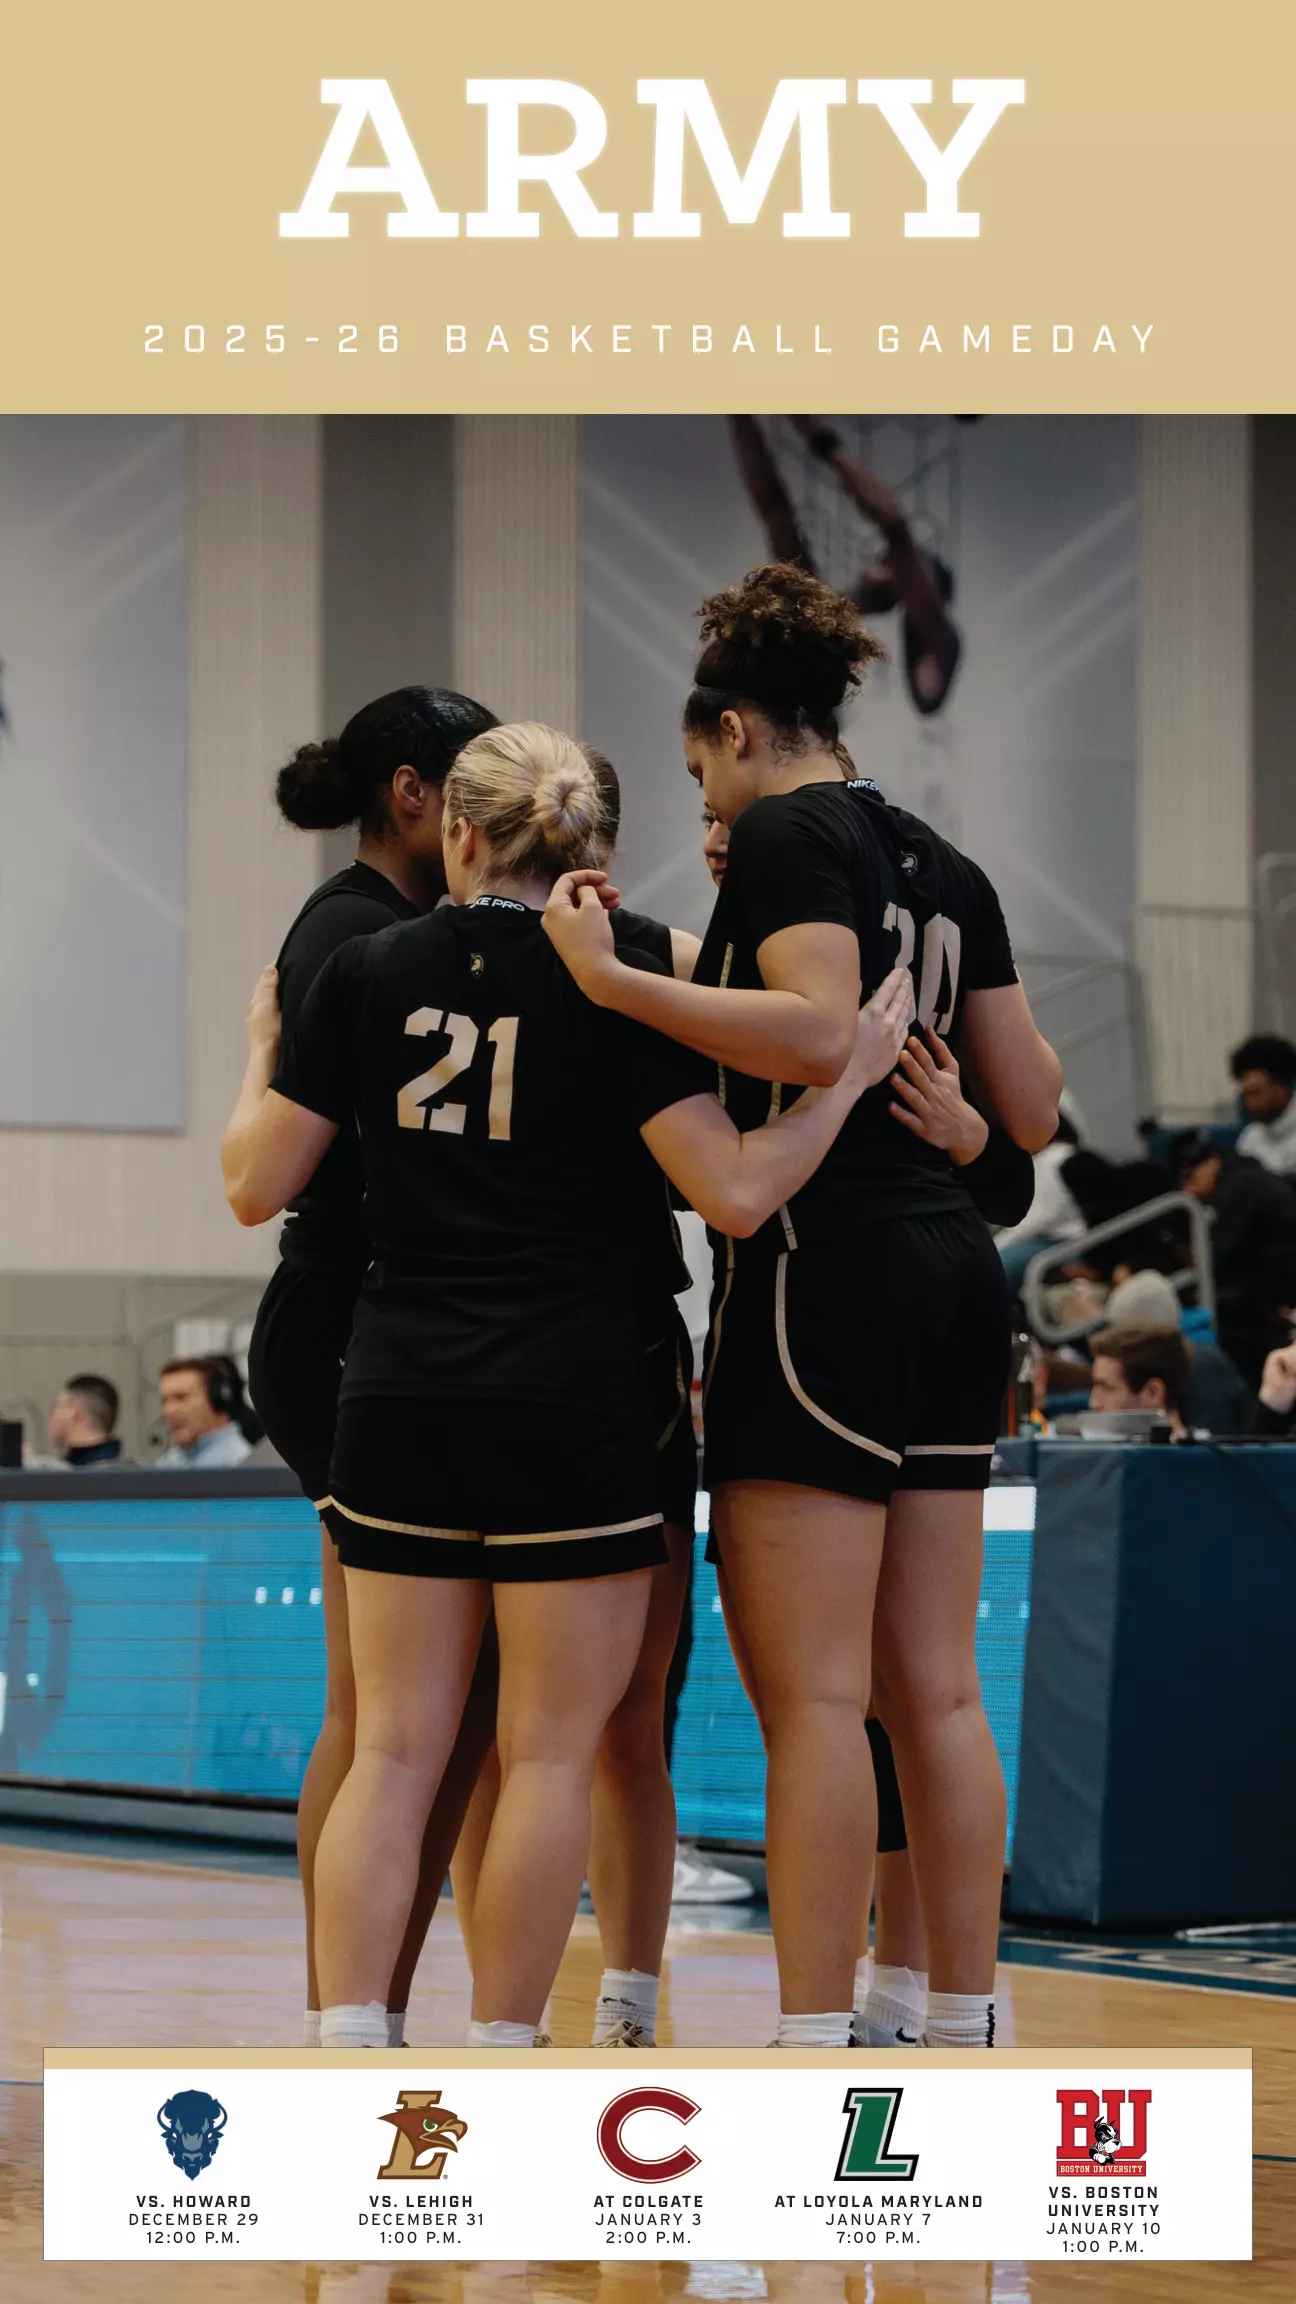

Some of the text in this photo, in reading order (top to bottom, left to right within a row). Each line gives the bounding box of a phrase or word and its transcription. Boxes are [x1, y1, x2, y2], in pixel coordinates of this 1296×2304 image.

[847, 779, 877, 791] NIKE
[491, 899, 525, 911] PRO
[396, 1006, 520, 1141] 21
